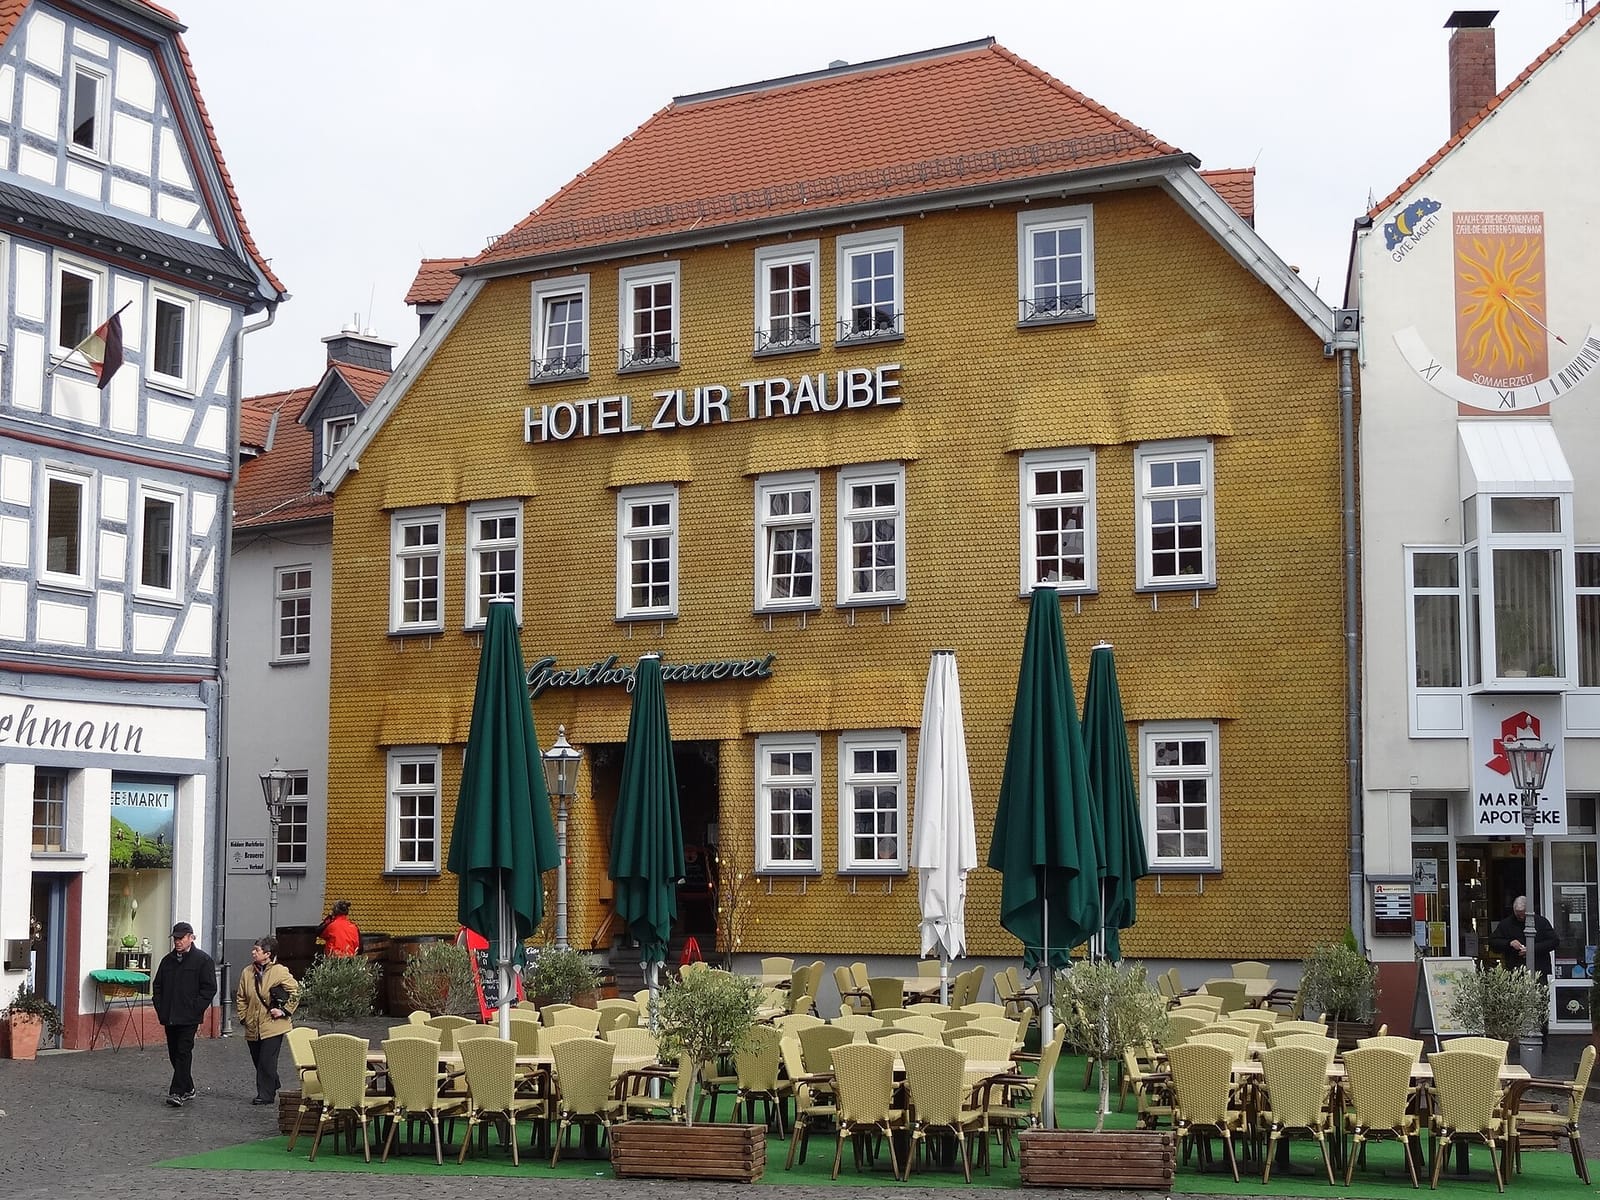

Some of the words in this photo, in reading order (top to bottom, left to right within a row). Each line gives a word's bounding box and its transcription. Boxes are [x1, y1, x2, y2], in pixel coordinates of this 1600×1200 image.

[1419, 358, 1443, 382] XI
[1472, 372, 1535, 389] SOMMERZEIT
[523, 394, 643, 443] HOTEL
[650, 383, 731, 430] ZUR
[739, 364, 902, 420] TRAUBE
[1498, 390, 1516, 409] XII
[128, 791, 169, 808] MARKT
[244, 850, 265, 859] Brauerei
